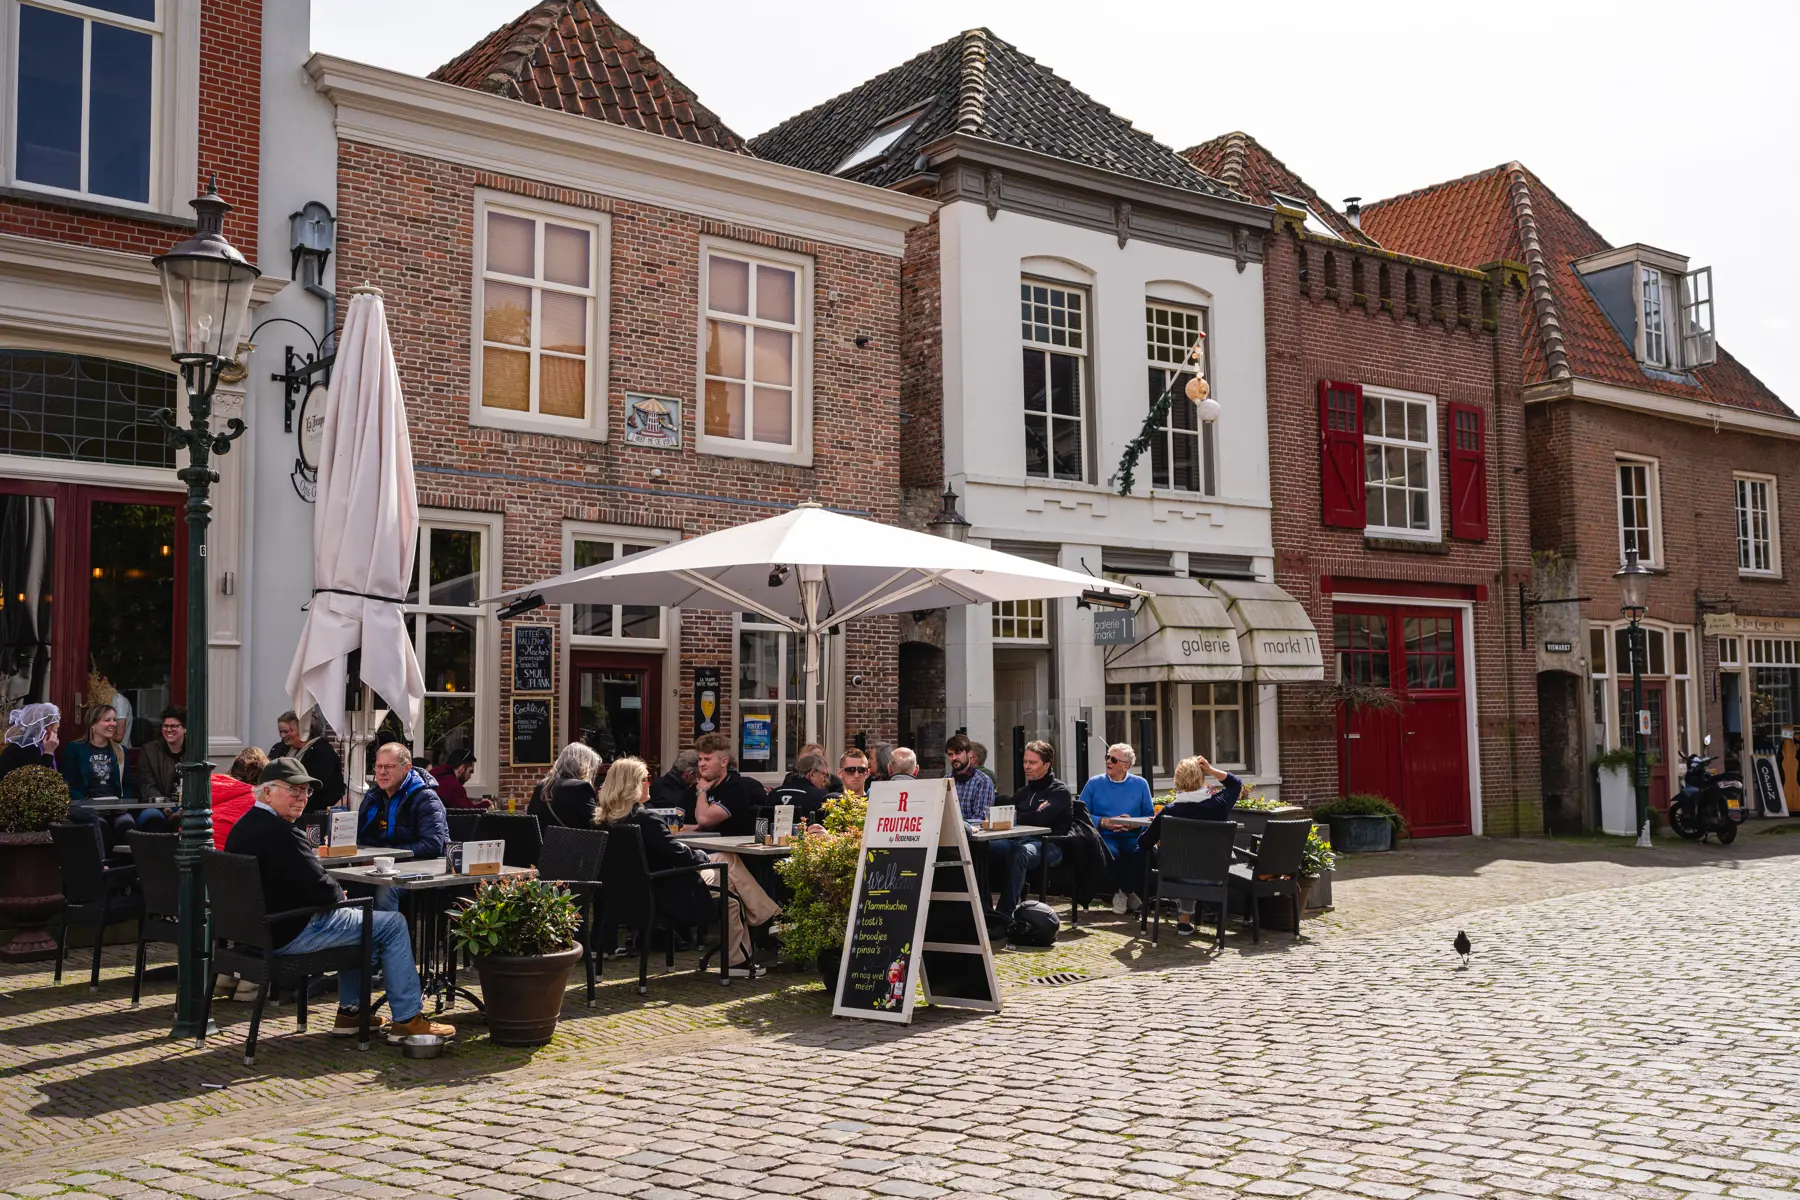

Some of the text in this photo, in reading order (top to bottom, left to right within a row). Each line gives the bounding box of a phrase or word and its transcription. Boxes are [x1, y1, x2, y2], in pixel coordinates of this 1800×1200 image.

[311, 485, 317, 498] G
[1095, 619, 1120, 632] galerie
[1122, 617, 1135, 638] 11
[1095, 631, 1116, 640] markt
[1181, 634, 1231, 656] galerie
[1264, 636, 1316, 653] markt 11
[529, 678, 550, 688] PLANK
[672, 688, 678, 696] 9
[514, 702, 548, 717] Cocktails
[1761, 766, 1776, 800] OPEN
[897, 791, 909, 813] R
[877, 816, 924, 833] FRUITAGE
[888, 836, 894, 844] by
[861, 916, 883, 926] tosti's
[858, 930, 888, 944] broodjes
[856, 945, 881, 958] pinsa's
[859, 971, 871, 984] nog
[872, 970, 885, 980] veel
[855, 980, 876, 991] meer!
